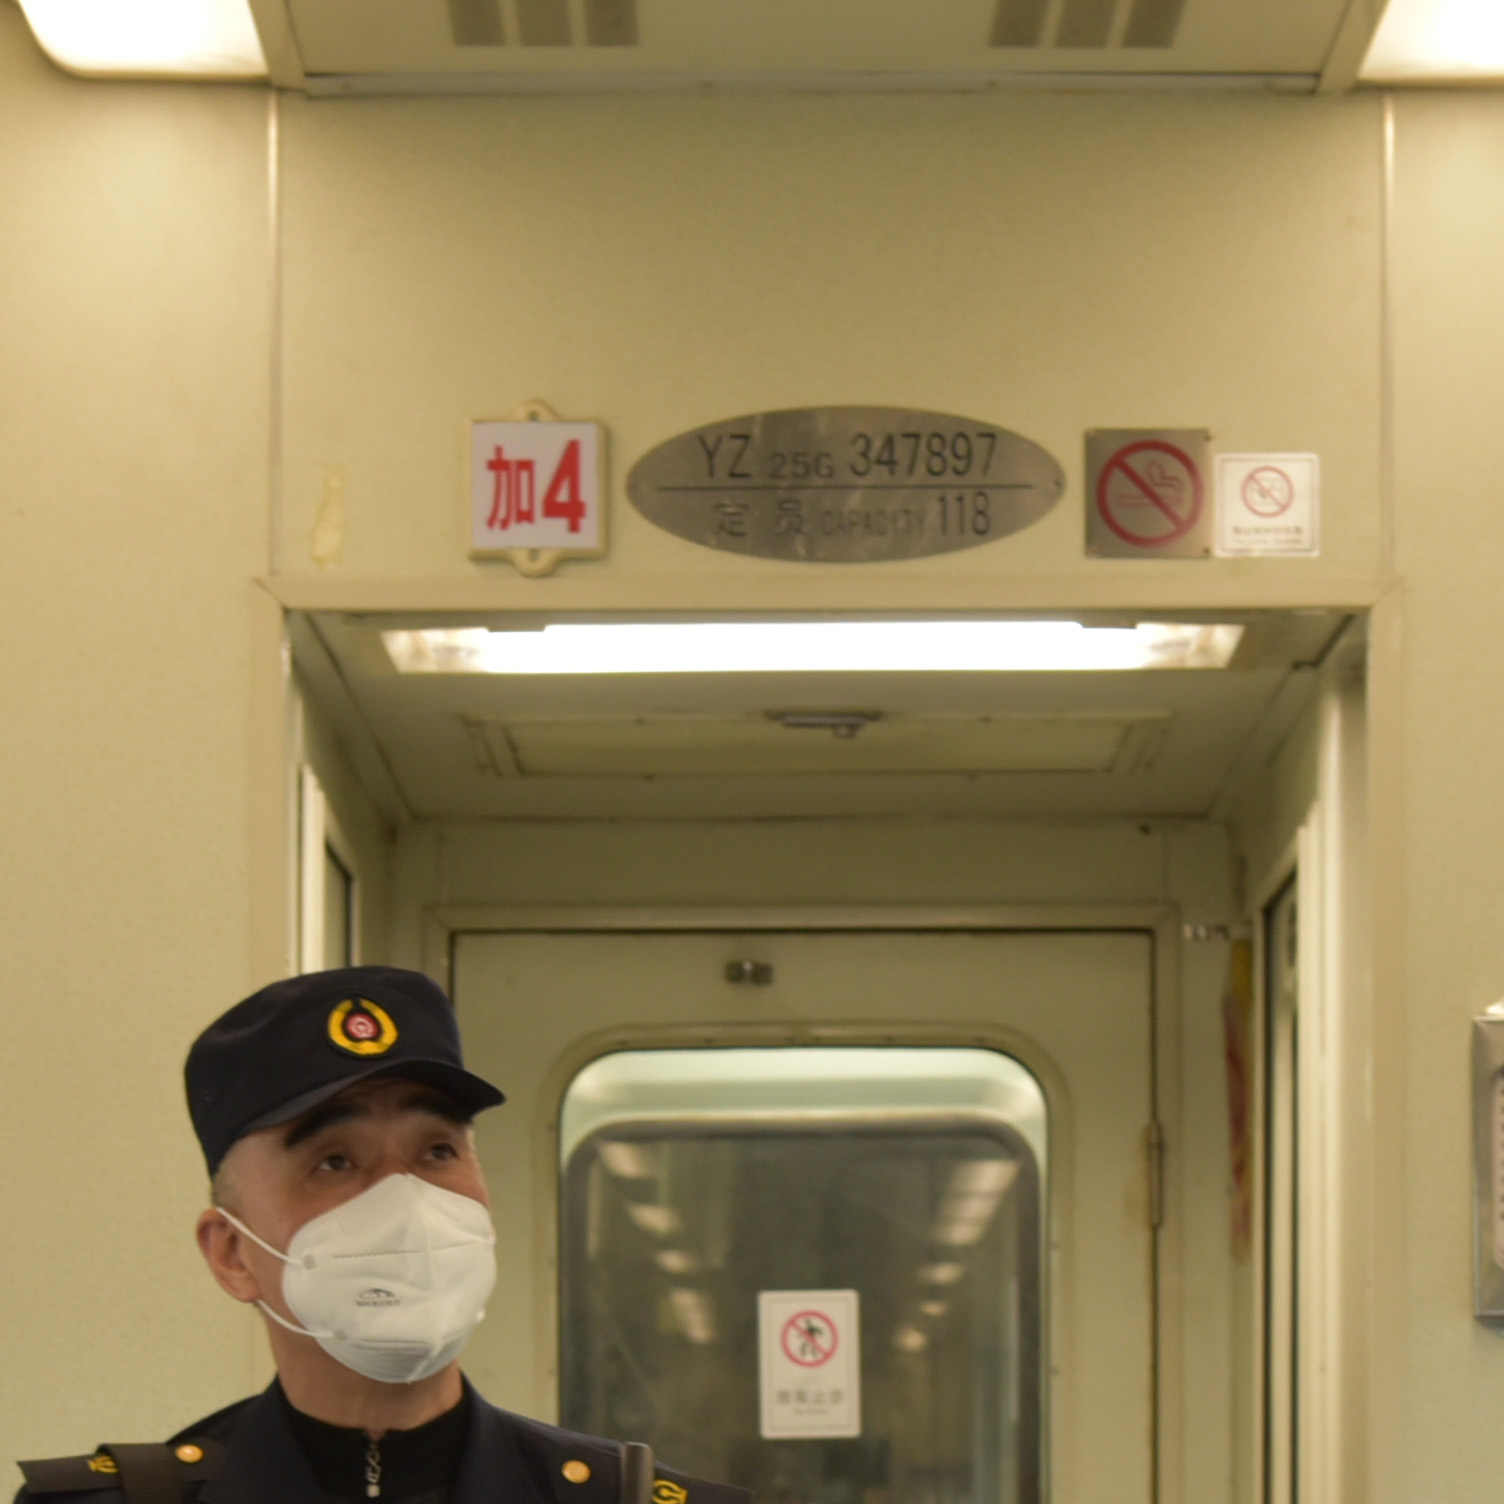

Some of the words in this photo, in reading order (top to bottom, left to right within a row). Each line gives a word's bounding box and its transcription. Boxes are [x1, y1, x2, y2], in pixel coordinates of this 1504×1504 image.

[699, 433, 753, 479] YZ
[769, 451, 835, 480] 25G
[848, 431, 996, 478] 347897
[486, 438, 586, 535] 加4
[935, 490, 992, 537] 118
